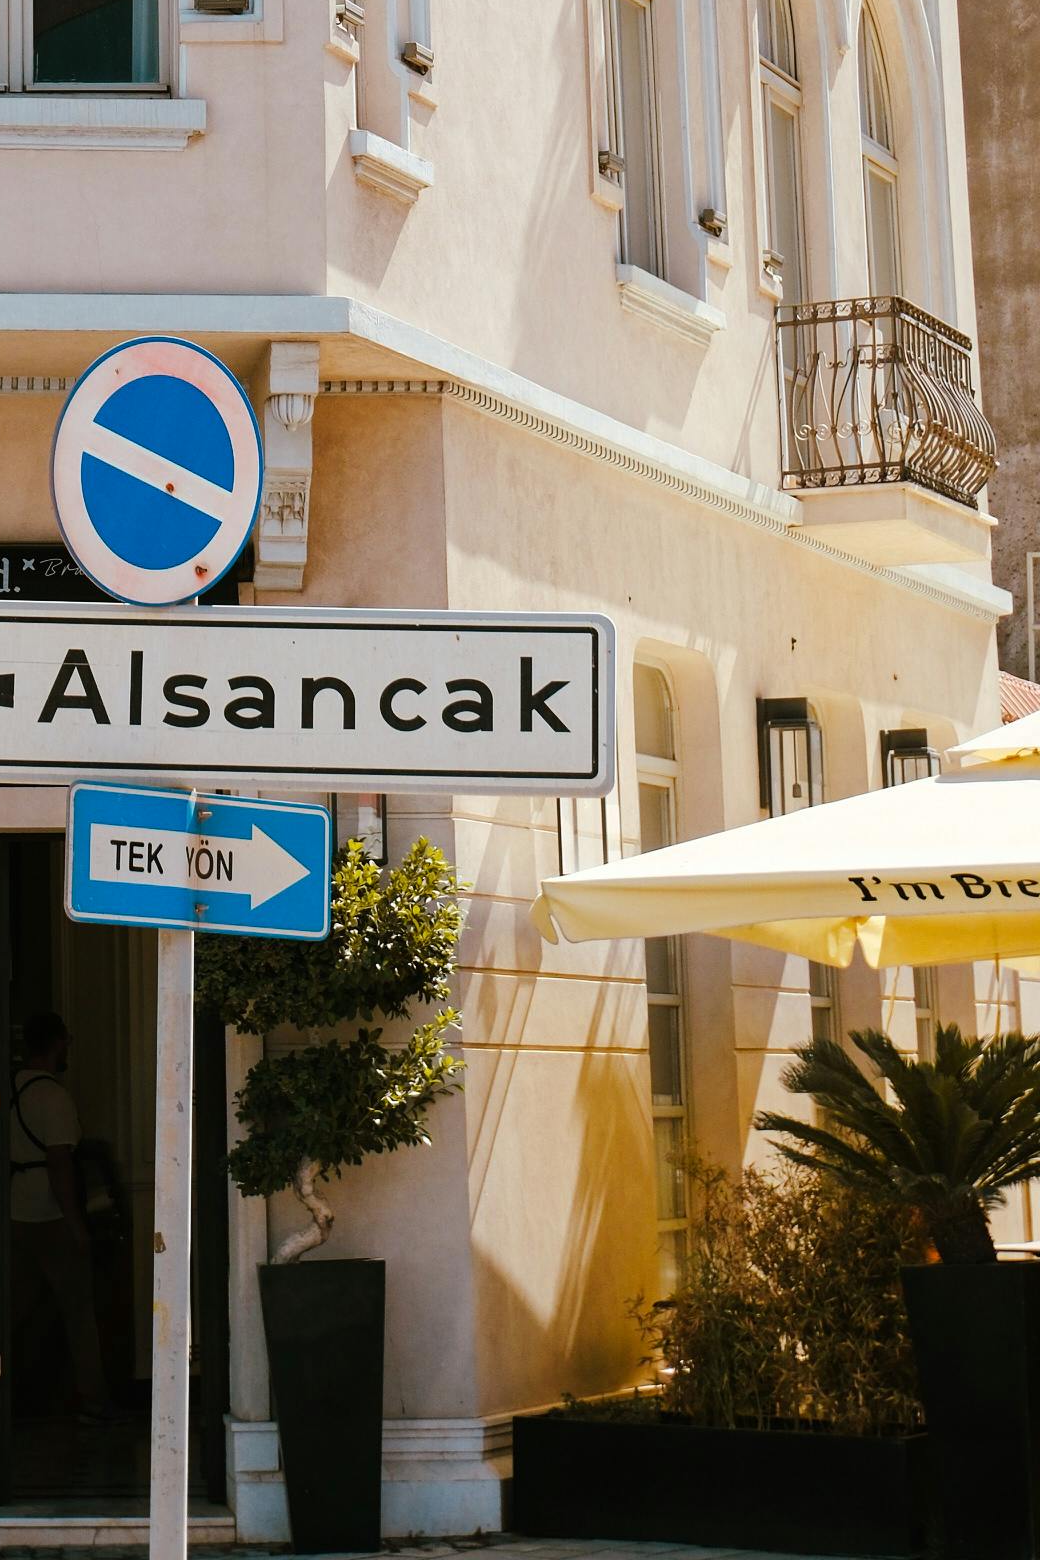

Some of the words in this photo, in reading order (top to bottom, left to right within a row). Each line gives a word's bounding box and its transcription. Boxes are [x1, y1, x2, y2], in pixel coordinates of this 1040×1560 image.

[37, 648, 572, 734] Alsancak
[110, 839, 164, 874] TEK
[185, 839, 234, 882] YÖN
[848, 875, 945, 902] I'm
